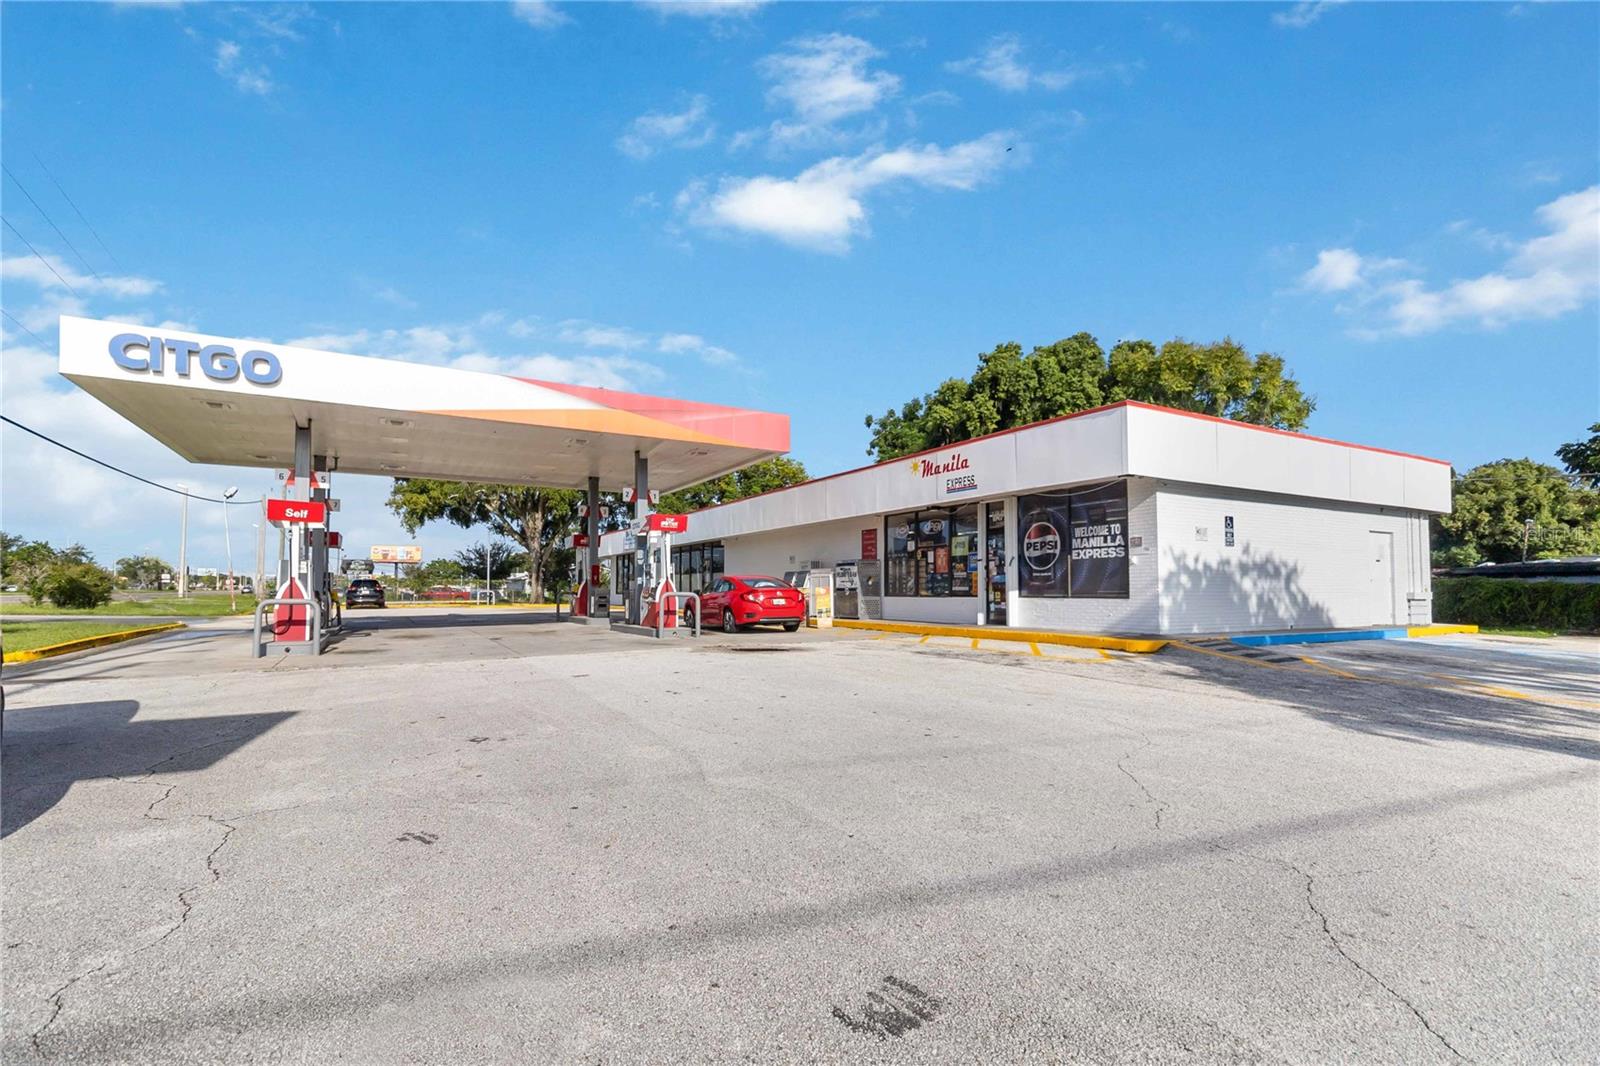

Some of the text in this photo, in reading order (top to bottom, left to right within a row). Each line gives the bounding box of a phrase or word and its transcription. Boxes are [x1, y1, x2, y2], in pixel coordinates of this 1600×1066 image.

[108, 333, 282, 384] CITGO
[921, 453, 969, 478] Manila
[278, 472, 285, 481] 6
[320, 475, 327, 483] 5
[946, 474, 975, 489] EXPRESS
[624, 490, 630, 498] 2
[285, 508, 308, 518] Self
[1074, 523, 1121, 538] WELCOME TO
[1026, 540, 1058, 551] PEPSI
[1072, 535, 1125, 549] MANILLA
[1072, 547, 1126, 560] EXPRESS
